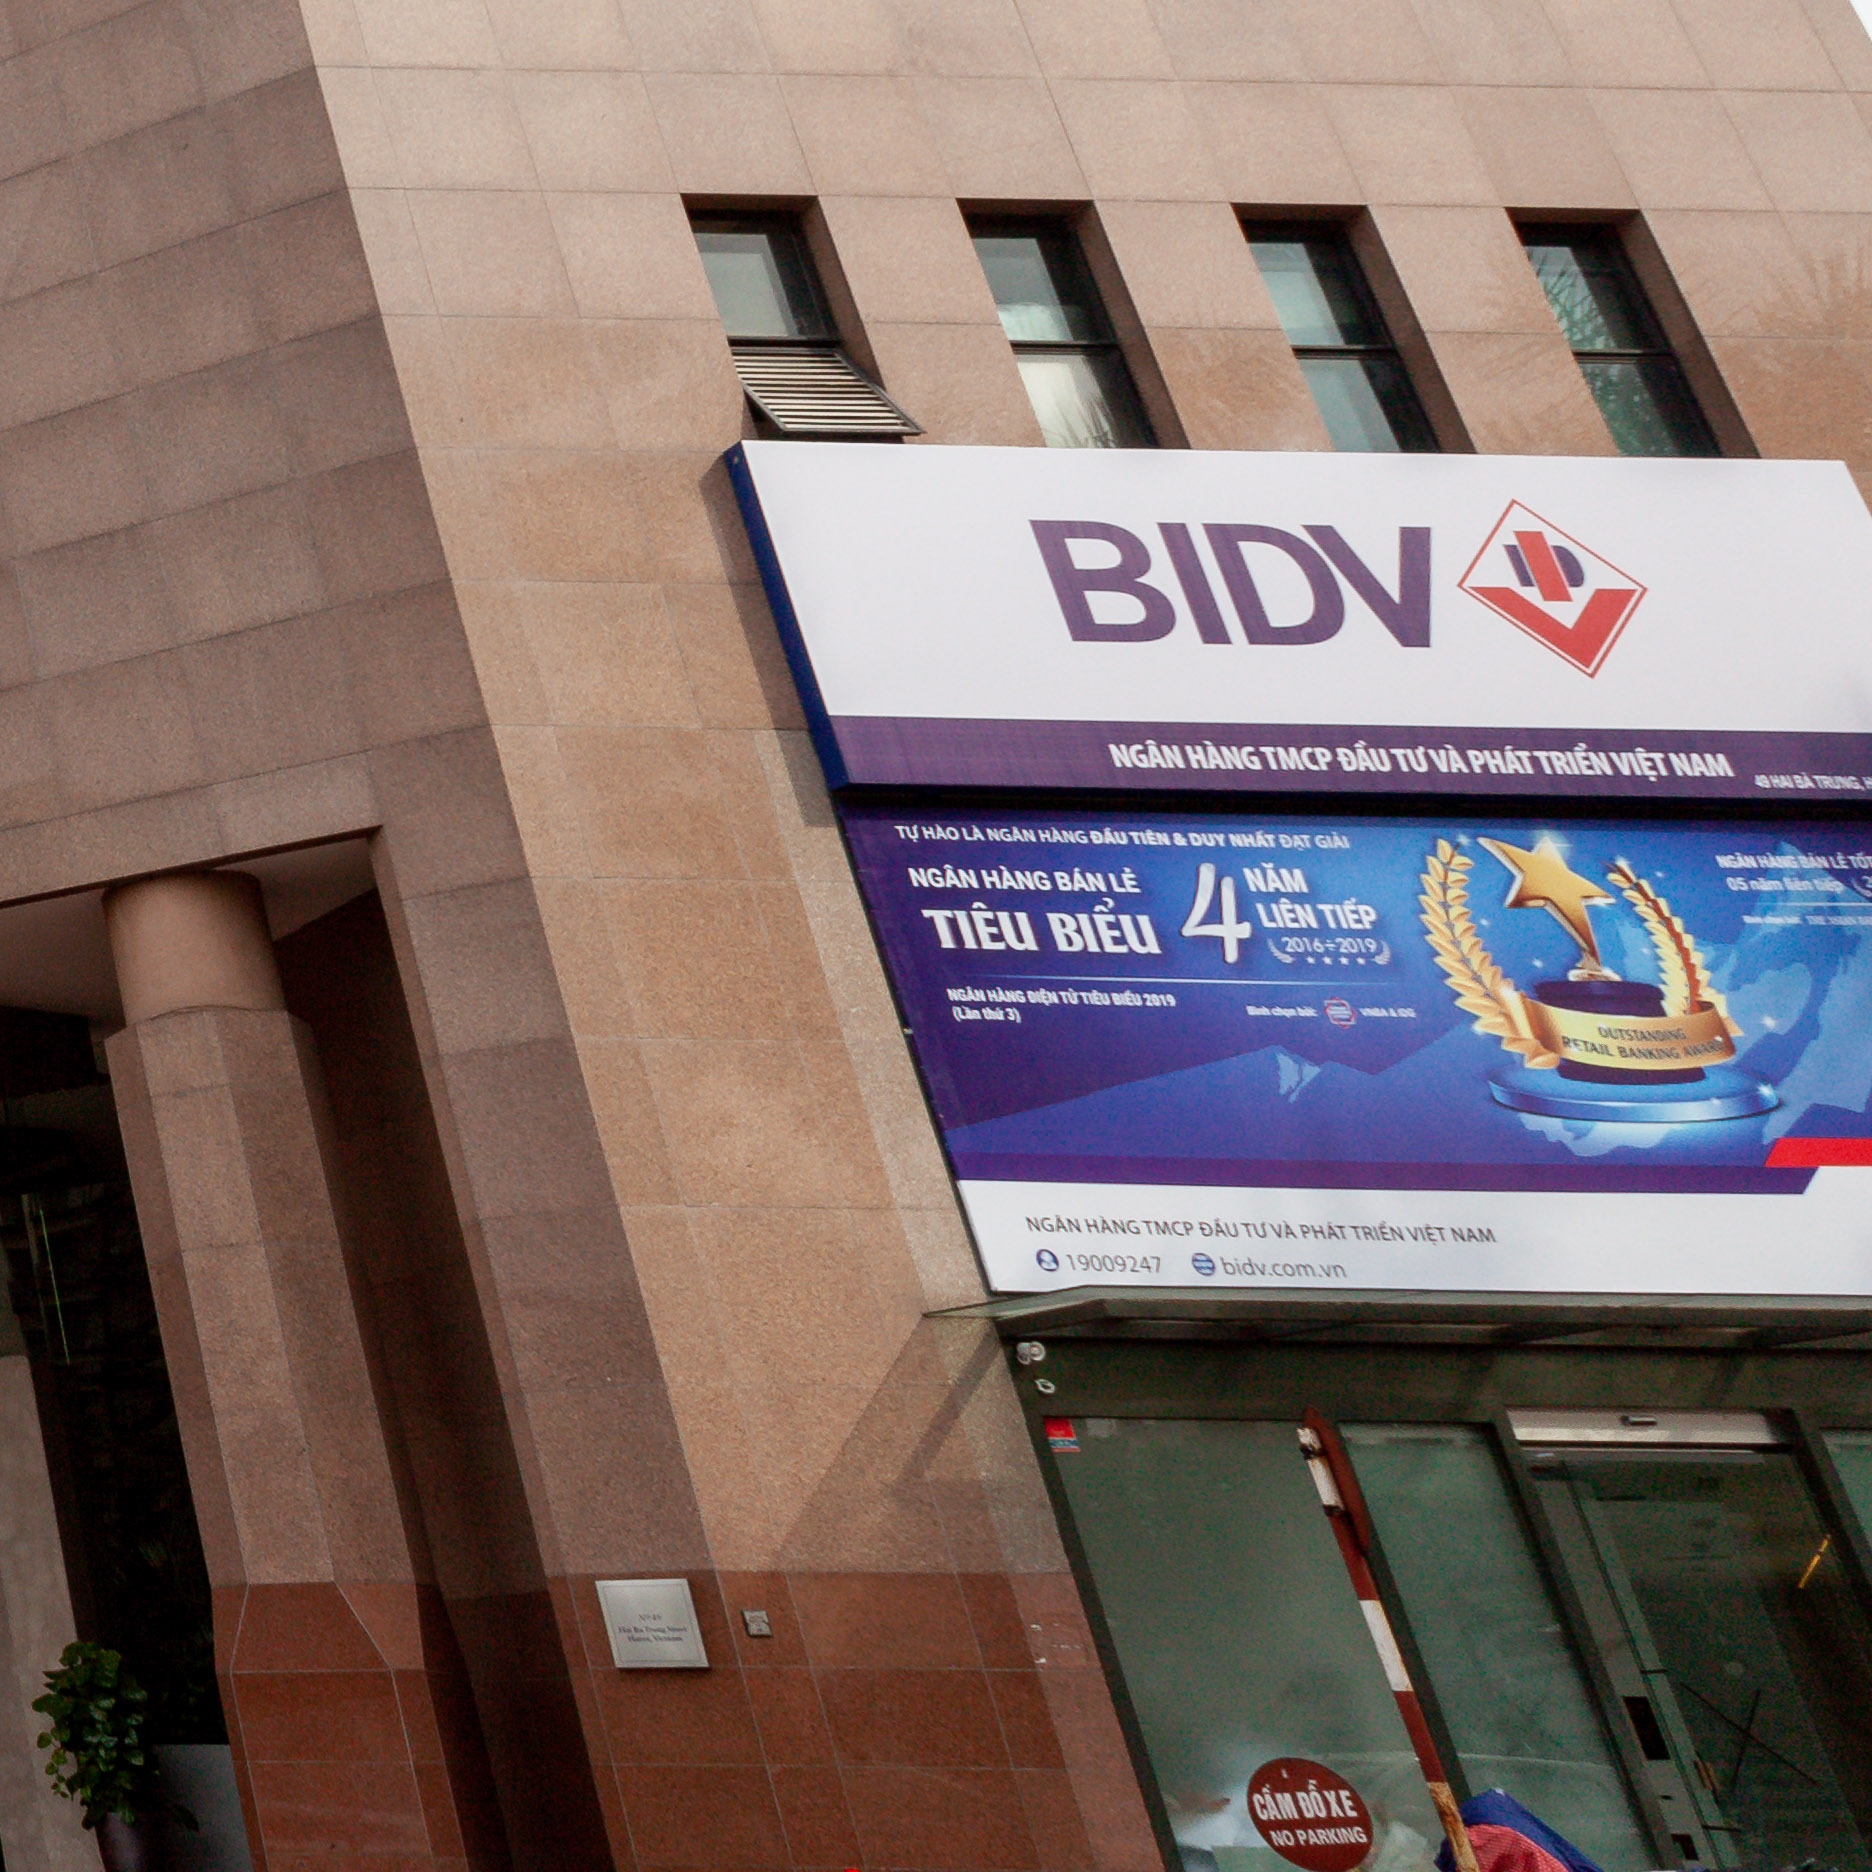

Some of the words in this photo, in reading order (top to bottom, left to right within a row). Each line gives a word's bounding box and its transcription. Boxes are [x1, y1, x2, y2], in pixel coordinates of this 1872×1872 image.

[1029, 519, 1431, 647] BIDV
[1108, 739, 1186, 769] NGÂN
[1185, 740, 1262, 770] HÀNG
[1259, 746, 1333, 771] TMCP
[1336, 740, 1392, 773] ĐẦU
[1391, 745, 1429, 773] TƯ
[1428, 744, 1469, 774] VÀ
[1467, 744, 1536, 776] PHÁT
[1534, 742, 1613, 776] TRIỂN
[1611, 747, 1666, 782] VIỆT
[1669, 752, 1736, 778] NAM
[894, 825, 919, 842] TỰ
[921, 824, 959, 841] HÀO
[961, 825, 985, 841] LÀ
[987, 826, 1037, 843] NGÂN
[1037, 827, 1088, 844] HÀNG
[1173, 832, 1188, 847] &
[1188, 833, 1225, 847] DUY
[908, 864, 979, 889] NGÂN
[980, 865, 1051, 891] HÀNG
[1053, 867, 1107, 892] BÁN
[1109, 867, 1142, 893] LẺ
[1242, 862, 1309, 894] NĂM
[921, 901, 1039, 952] TIÊU
[1046, 897, 1162, 954] BIỂU
[1181, 863, 1252, 964] 4
[1255, 897, 1319, 929] LIÊN
[1316, 897, 1378, 930] TIẾP
[1142, 993, 1176, 1007] 2019
[1006, 1008, 1022, 1024] 3)
[1562, 1035, 1614, 1056] RETAIL
[1617, 1044, 1681, 1060] BANKING
[1597, 1025, 1688, 1042] OUTSTANDING
[1026, 1215, 1083, 1234] NGÂN
[1085, 1216, 1140, 1235] HÀNG
[1142, 1220, 1194, 1238] TMCP
[1198, 1218, 1240, 1239] ĐẦU
[1242, 1222, 1267, 1239] TƯ
[1269, 1220, 1297, 1240] VÀ
[1300, 1221, 1348, 1241] PHÁT
[1351, 1220, 1404, 1242] TRIỂN
[1407, 1223, 1449, 1246] VIỆT
[1451, 1226, 1496, 1243] NAM
[1066, 1253, 1162, 1274] 19009247
[1221, 1256, 1346, 1278] bidv.com.vn
[1253, 1784, 1299, 1820] CẤM
[1296, 1779, 1327, 1818] ĐỖ
[1323, 1790, 1358, 1817] XE
[1269, 1829, 1295, 1846] NO
[1295, 1826, 1368, 1846] PARKING
